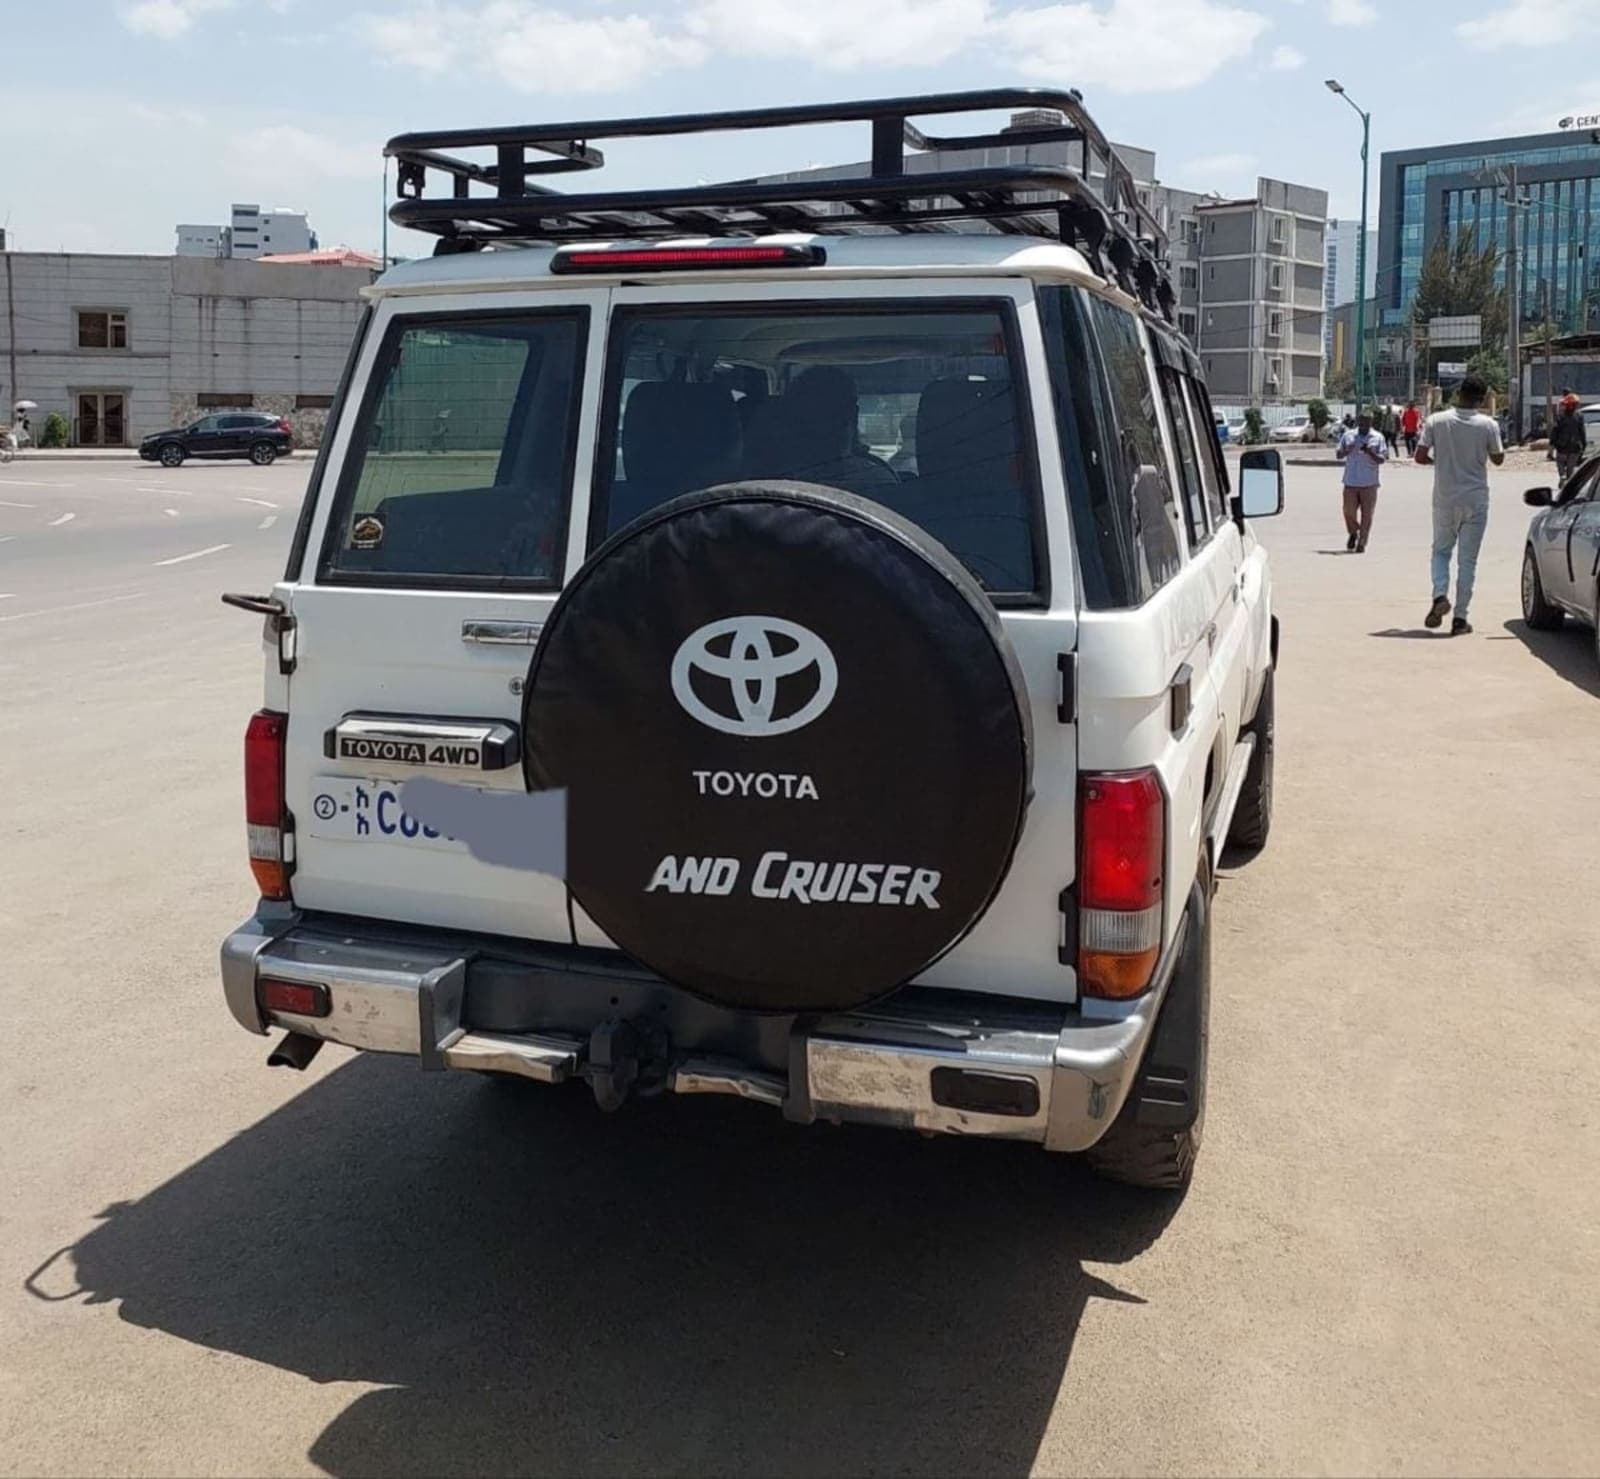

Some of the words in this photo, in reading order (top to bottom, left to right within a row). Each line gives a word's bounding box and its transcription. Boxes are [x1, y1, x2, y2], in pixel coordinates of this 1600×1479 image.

[1577, 115, 1600, 127] CEN
[344, 740, 421, 761] TOYOTA
[428, 745, 480, 765] 4WD
[692, 771, 819, 800] TOYOTA
[643, 854, 740, 895] AND
[751, 851, 942, 909] CRUISER
